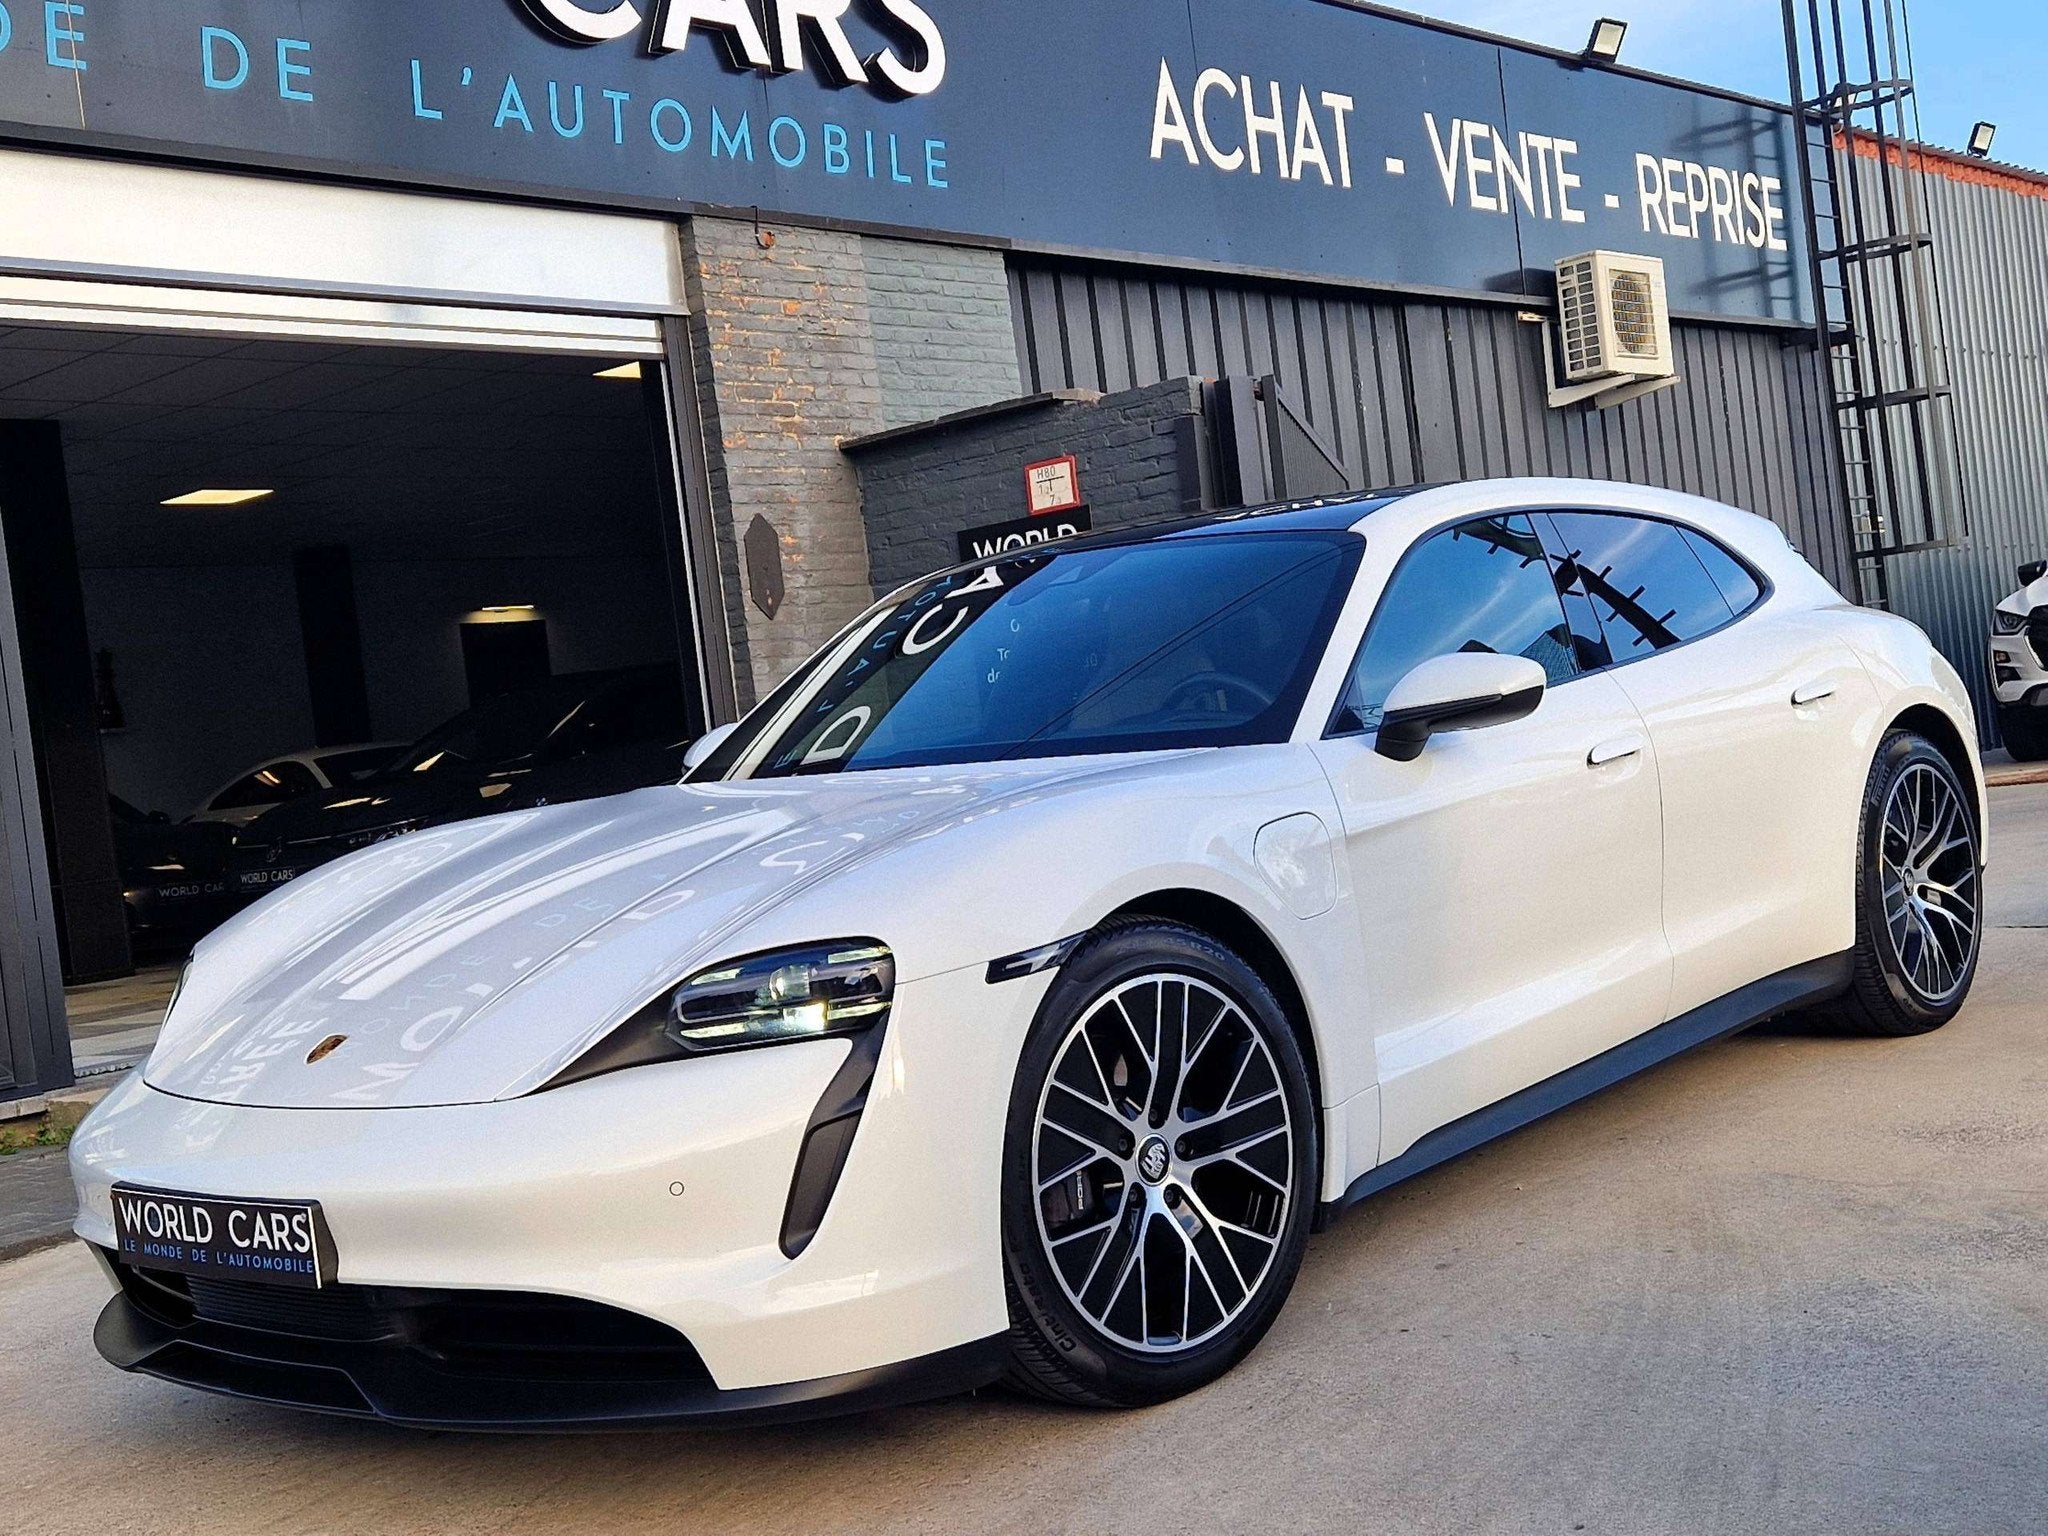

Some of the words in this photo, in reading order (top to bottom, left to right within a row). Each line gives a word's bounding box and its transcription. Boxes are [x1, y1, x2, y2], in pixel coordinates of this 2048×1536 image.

[0, 0, 87, 70] E
[201, 27, 313, 102] DE
[410, 59, 949, 188] L'AUTOMOBILE
[1150, 57, 1352, 188] ACHAT
[1424, 112, 1585, 223] VENTE
[1636, 152, 1787, 251] REPRISE
[159, 885, 199, 897] WORLD
[240, 872, 268, 884] WORLD
[271, 869, 293, 881] CARS
[117, 1197, 213, 1244] WORLD
[228, 1209, 311, 1254] CARS
[124, 1240, 136, 1252] LE
[143, 1242, 183, 1260] MONDE
[192, 1249, 207, 1263] DE
[216, 1251, 313, 1274] L'AUTOMOBILE
